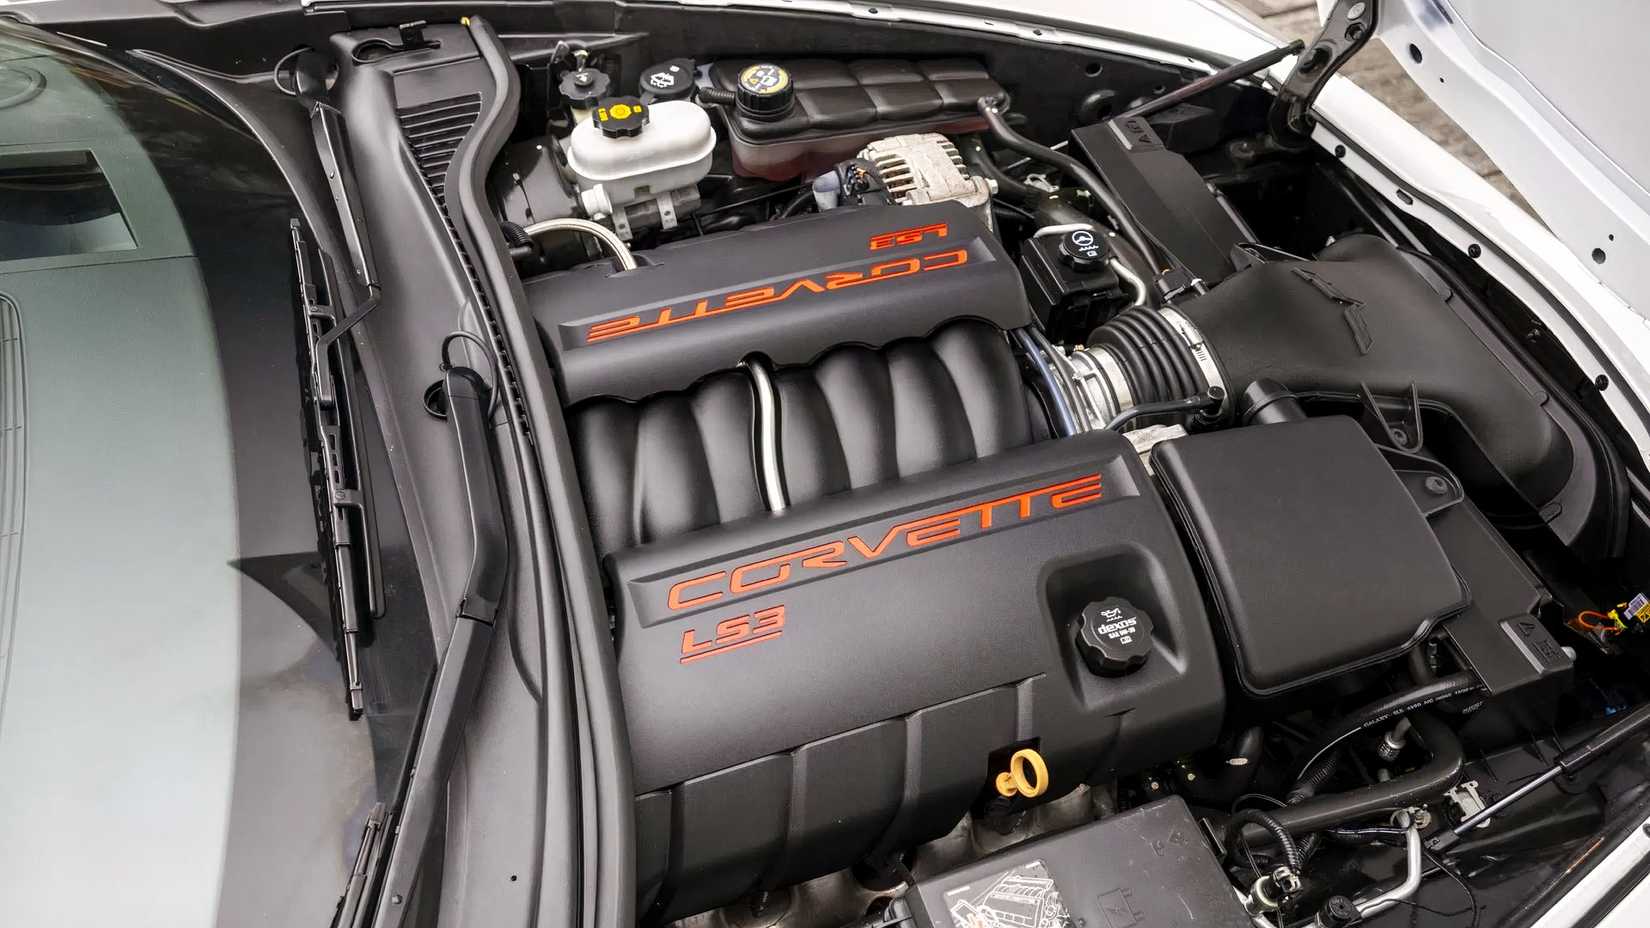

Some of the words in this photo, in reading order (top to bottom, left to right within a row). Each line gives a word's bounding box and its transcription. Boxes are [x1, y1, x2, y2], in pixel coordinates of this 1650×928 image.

[869, 223, 948, 251] LS3
[587, 248, 969, 344] CORVETTE
[668, 474, 1104, 611] CORVETTE
[679, 604, 785, 657] LS3
[1097, 617, 1137, 635] dexos
